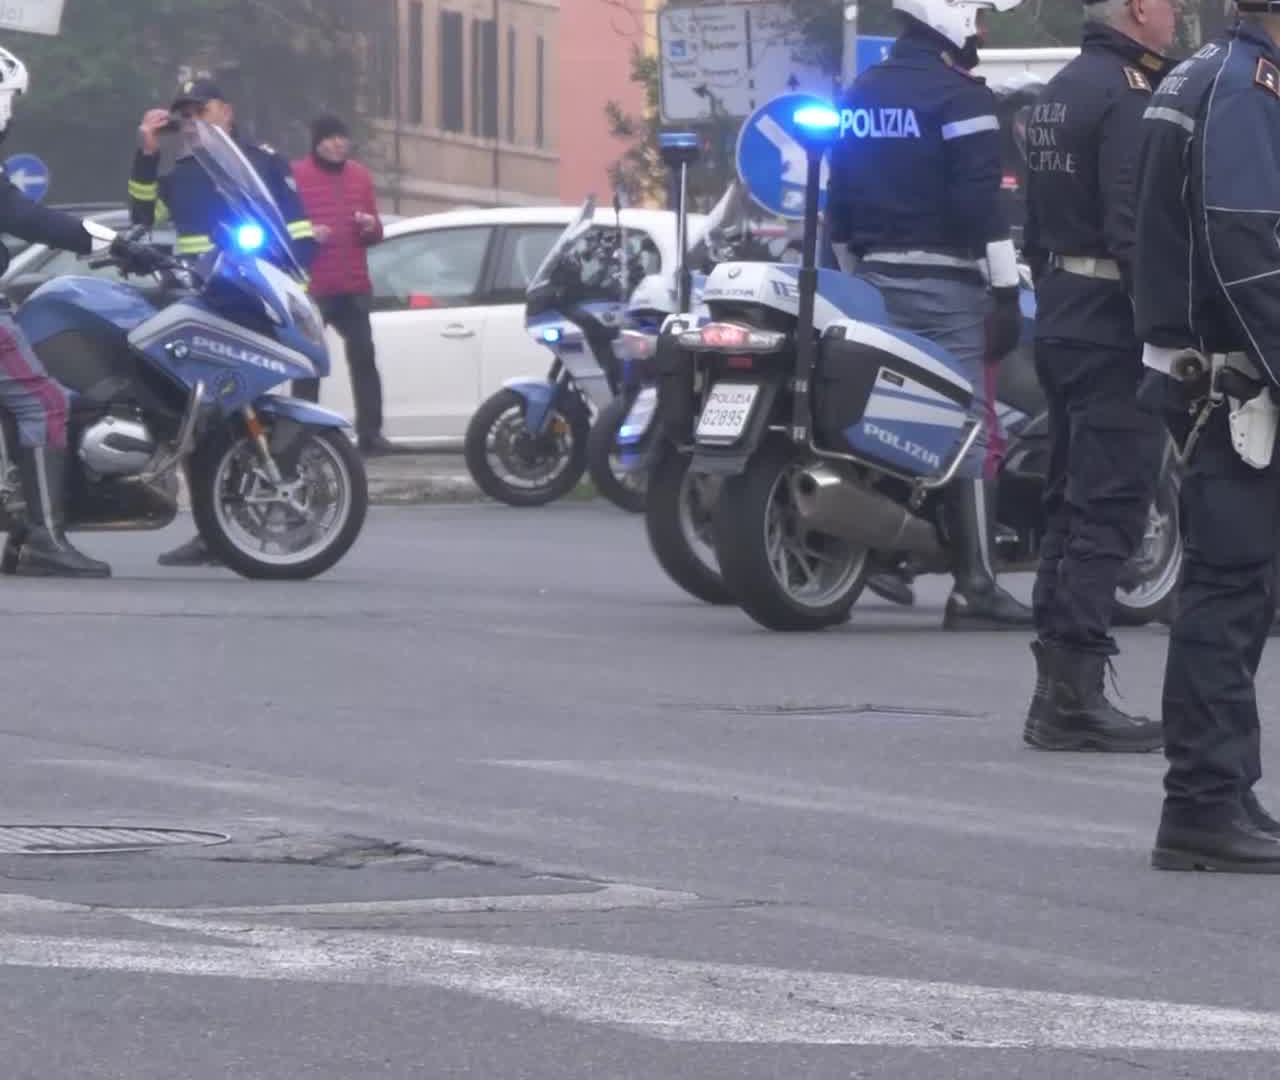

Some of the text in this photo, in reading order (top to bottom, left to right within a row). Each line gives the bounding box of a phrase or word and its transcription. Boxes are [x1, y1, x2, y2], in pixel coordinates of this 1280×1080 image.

[840, 107, 921, 138] POLIZIA
[191, 335, 287, 374] POLIZIA
[710, 392, 752, 404] POLIZIA
[863, 423, 940, 468] POLIZIA
